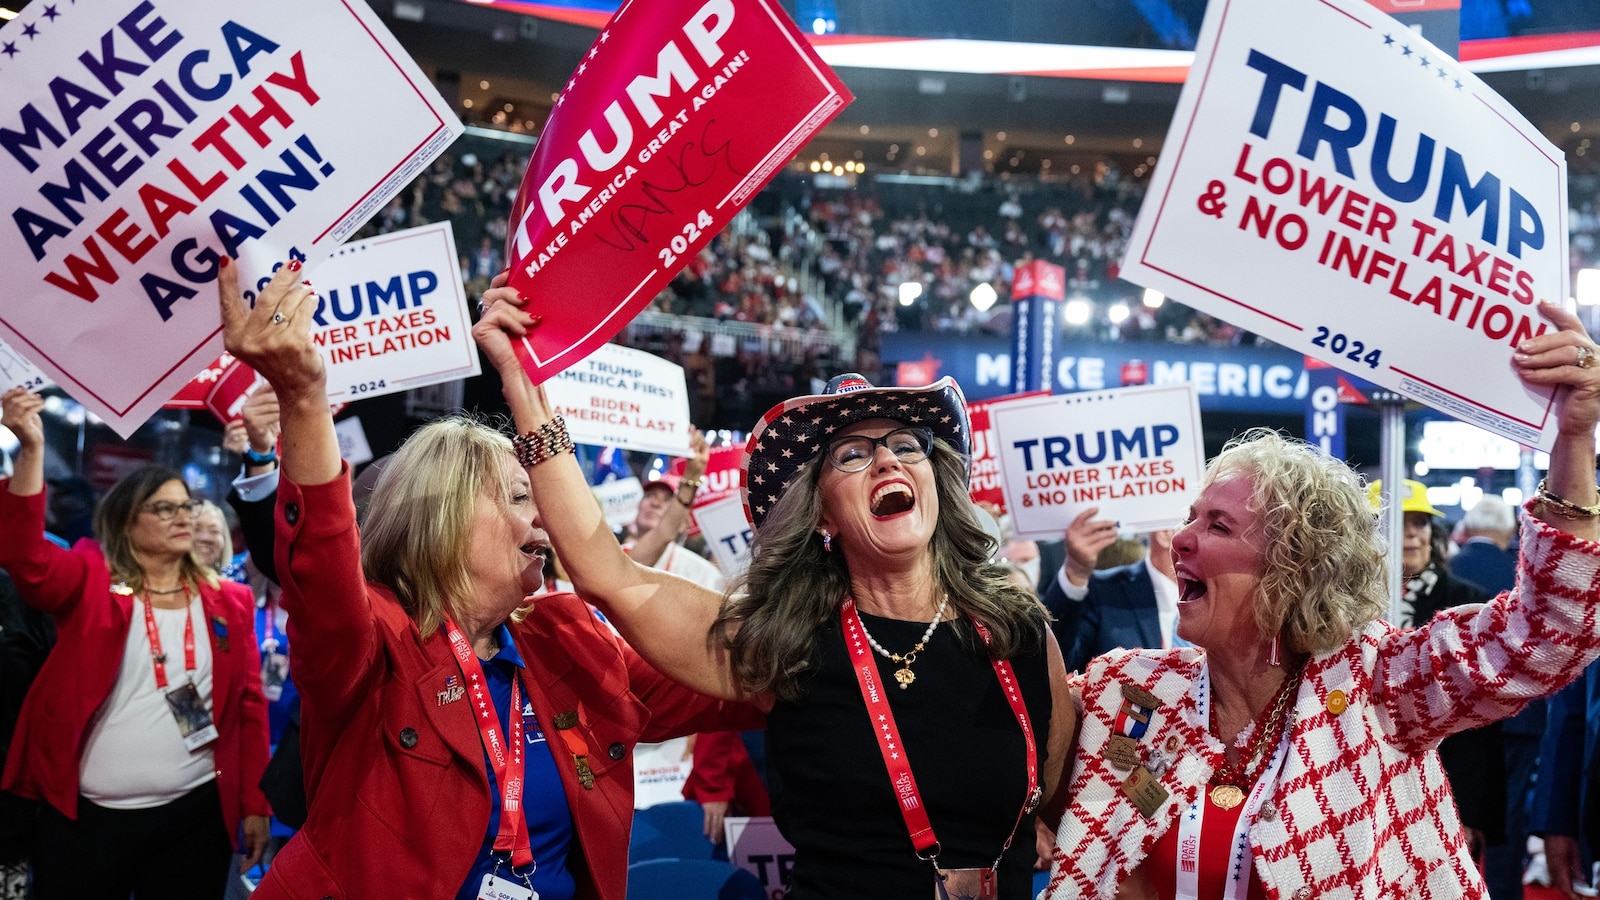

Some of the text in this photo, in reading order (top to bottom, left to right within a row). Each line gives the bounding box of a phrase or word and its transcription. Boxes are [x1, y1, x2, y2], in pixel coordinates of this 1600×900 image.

[0, 0, 184, 173] MAKE
[12, 20, 280, 262] AMERICA
[511, 0, 736, 261] TRUMP
[525, 50, 750, 278] MAKE AMERICA GREAT AGAIN!
[1246, 48, 1545, 260] TRUMP
[44, 50, 320, 303] WEALTHY
[140, 134, 335, 322] AGAIN!
[659, 209, 714, 270] 2024
[1234, 143, 1535, 306] LOWER TAXES
[1197, 179, 1548, 350] & NO INFLATION
[313, 270, 438, 326] RUMP
[314, 310, 436, 347] WER TAXES
[331, 327, 451, 364] INFLATION
[1311, 326, 1382, 369] 2024
[351, 380, 386, 394] 2024
[588, 360, 643, 378] TRUMP
[590, 396, 641, 414] BIDEN
[633, 382, 674, 398] FIRST
[554, 405, 676, 433] AMERICA LAST
[1312, 386, 1337, 457] OHI
[1013, 424, 1179, 471] TRUMP
[1022, 478, 1186, 507] & NO INFLATION
[1027, 461, 1174, 489] LOWER TAXES
[455, 640, 469, 663] TRUST
[460, 636, 471, 656] DATA
[437, 686, 465, 706] TRUMP
[862, 666, 879, 703] RNC2024
[488, 729, 506, 767] RNC2024
[506, 781, 514, 799] DATA
[896, 778, 908, 799] DATA
[900, 772, 914, 796] TRUST
[1245, 782, 1266, 819] RNC2024
[1181, 839, 1189, 859] DATA
[1188, 834, 1196, 859] TRUST
